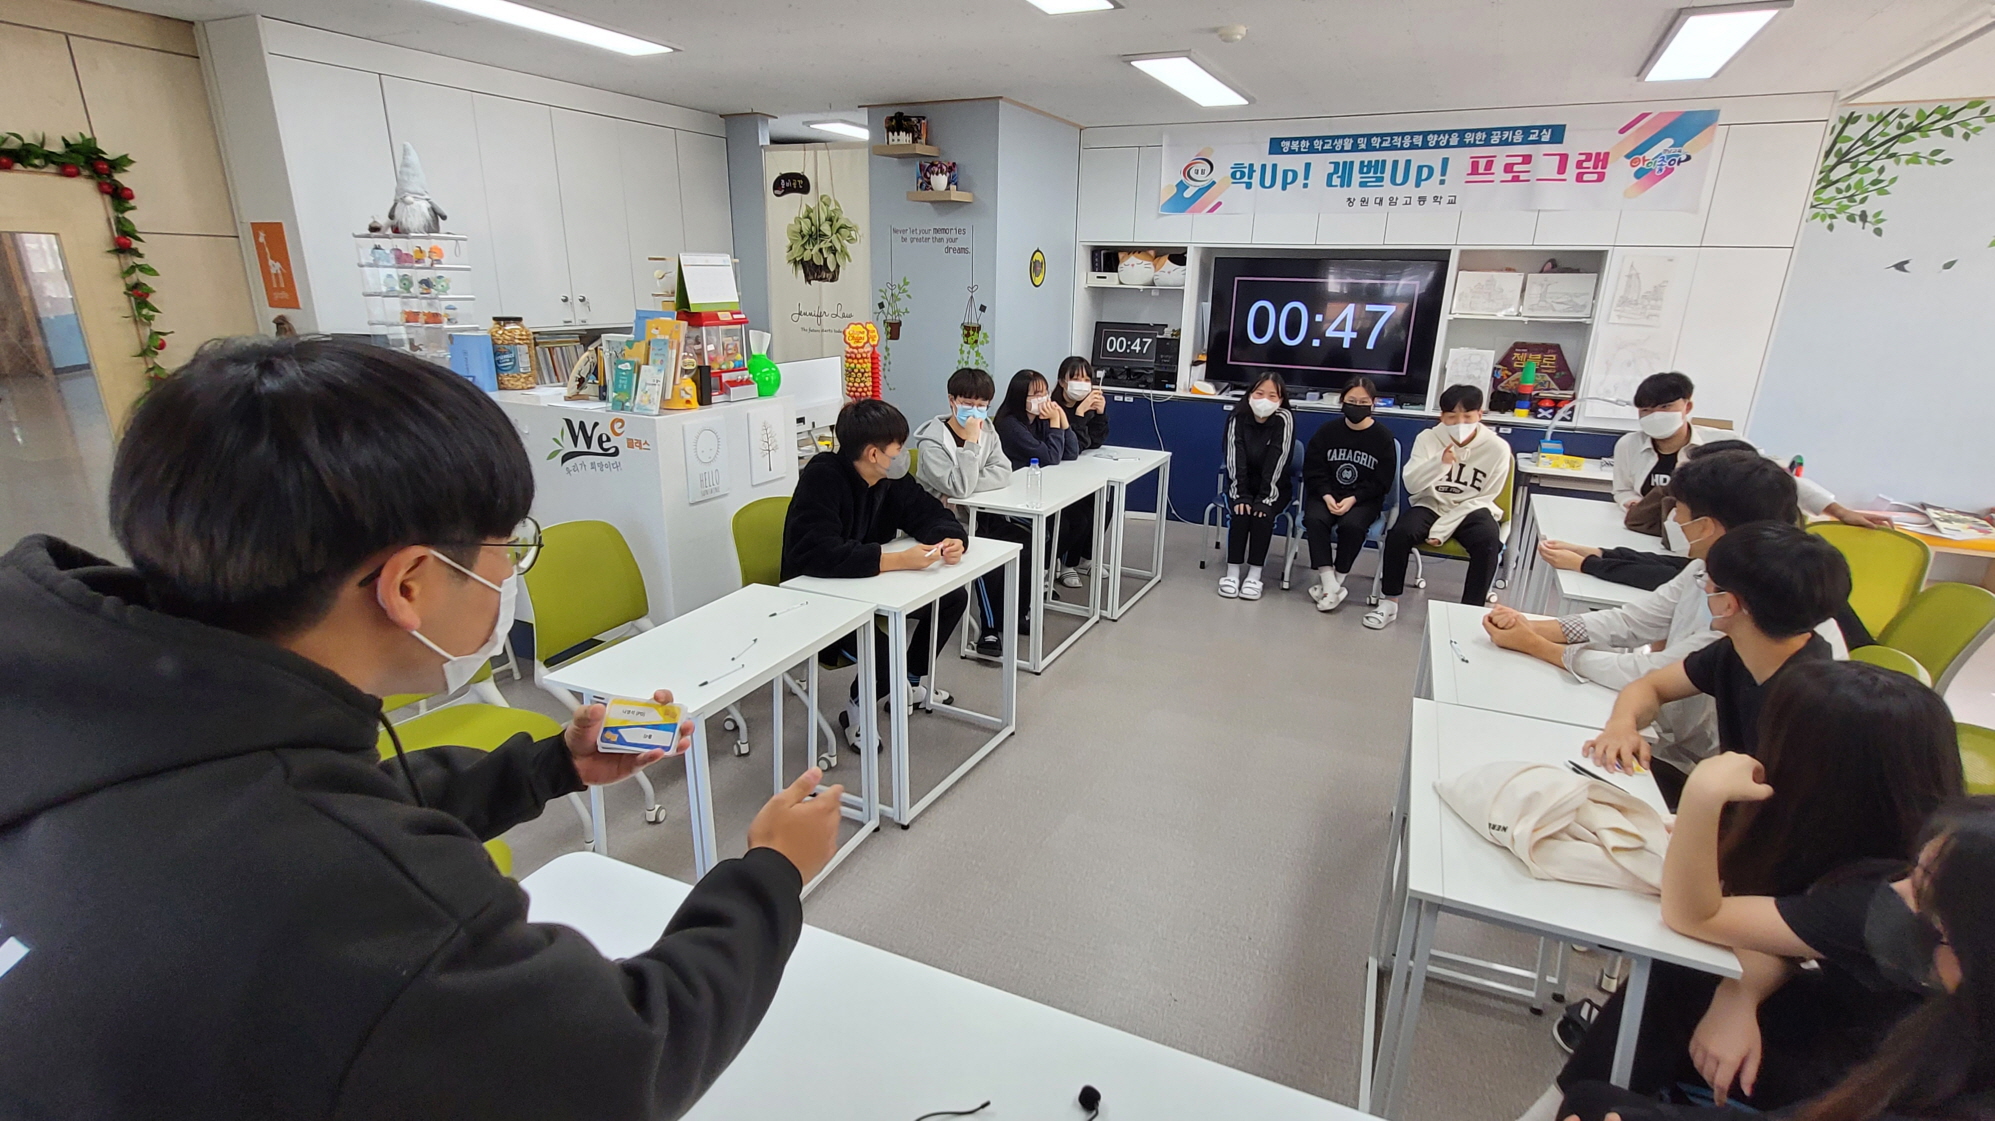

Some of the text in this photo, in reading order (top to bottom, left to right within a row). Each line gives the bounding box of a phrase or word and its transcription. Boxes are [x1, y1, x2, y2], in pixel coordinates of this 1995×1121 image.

[1280, 139, 1310, 152] 행복한
[1313, 137, 1354, 151] 학교생활
[1357, 137, 1367, 149] 및
[1370, 134, 1423, 149] 학교적응력
[1427, 133, 1459, 147] 향상을
[1464, 131, 1486, 144] 위한
[1528, 128, 1552, 142] 교실
[1230, 151, 1610, 191] 학Up! 레벨Up! 프로그램
[1346, 194, 1458, 208] 창원대암고등학교
[893, 227, 967, 236] Never let your memories
[910, 236, 931, 244] greater
[944, 245, 971, 255] dreams.
[791, 302, 829, 326] Jennifer
[1246, 299, 1397, 350] 00:47
[1106, 336, 1153, 354] 00:47
[565, 461, 587, 477] 우리가
[1439, 463, 1487, 492] ALE
[699, 469, 720, 489] HELLO
